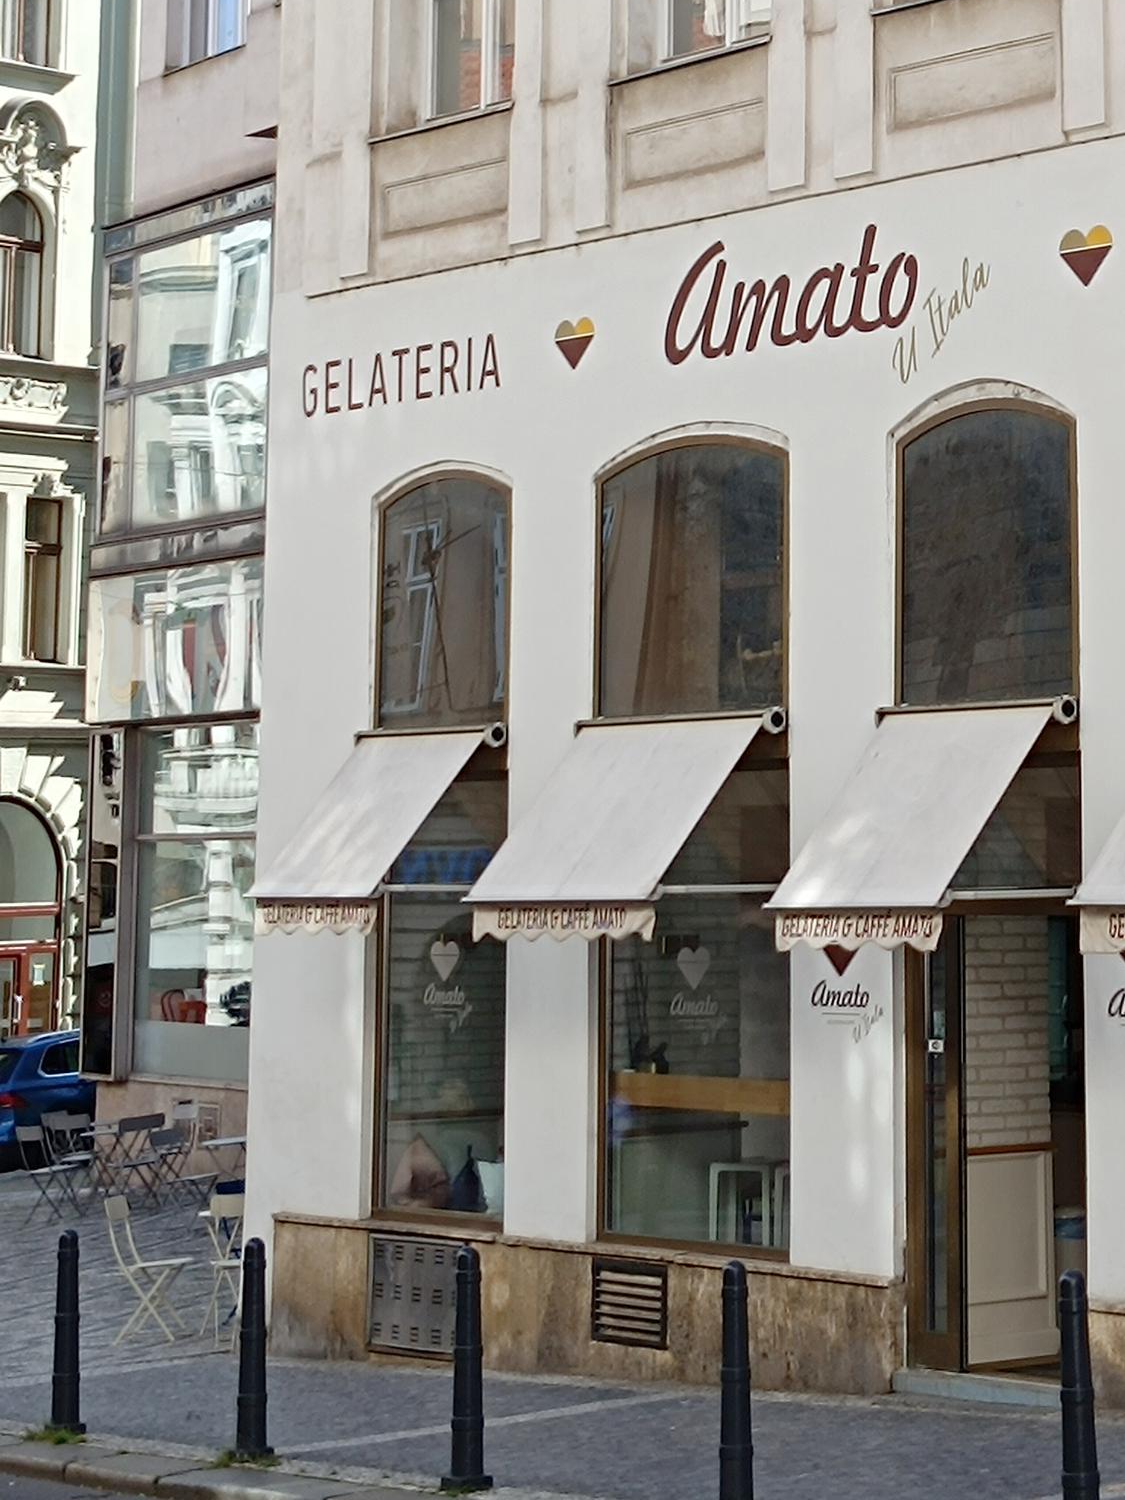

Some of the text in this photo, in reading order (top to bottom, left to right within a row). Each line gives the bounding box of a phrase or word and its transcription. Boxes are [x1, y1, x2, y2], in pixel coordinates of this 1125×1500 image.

[301, 333, 501, 418] GELATERIA
[497, 908, 549, 930] GELATERIA
[561, 903, 591, 930] CAFFÉ
[782, 913, 838, 938] GELATERIA
[854, 908, 889, 938] CAFFÉ
[892, 912, 933, 938] AMATO
